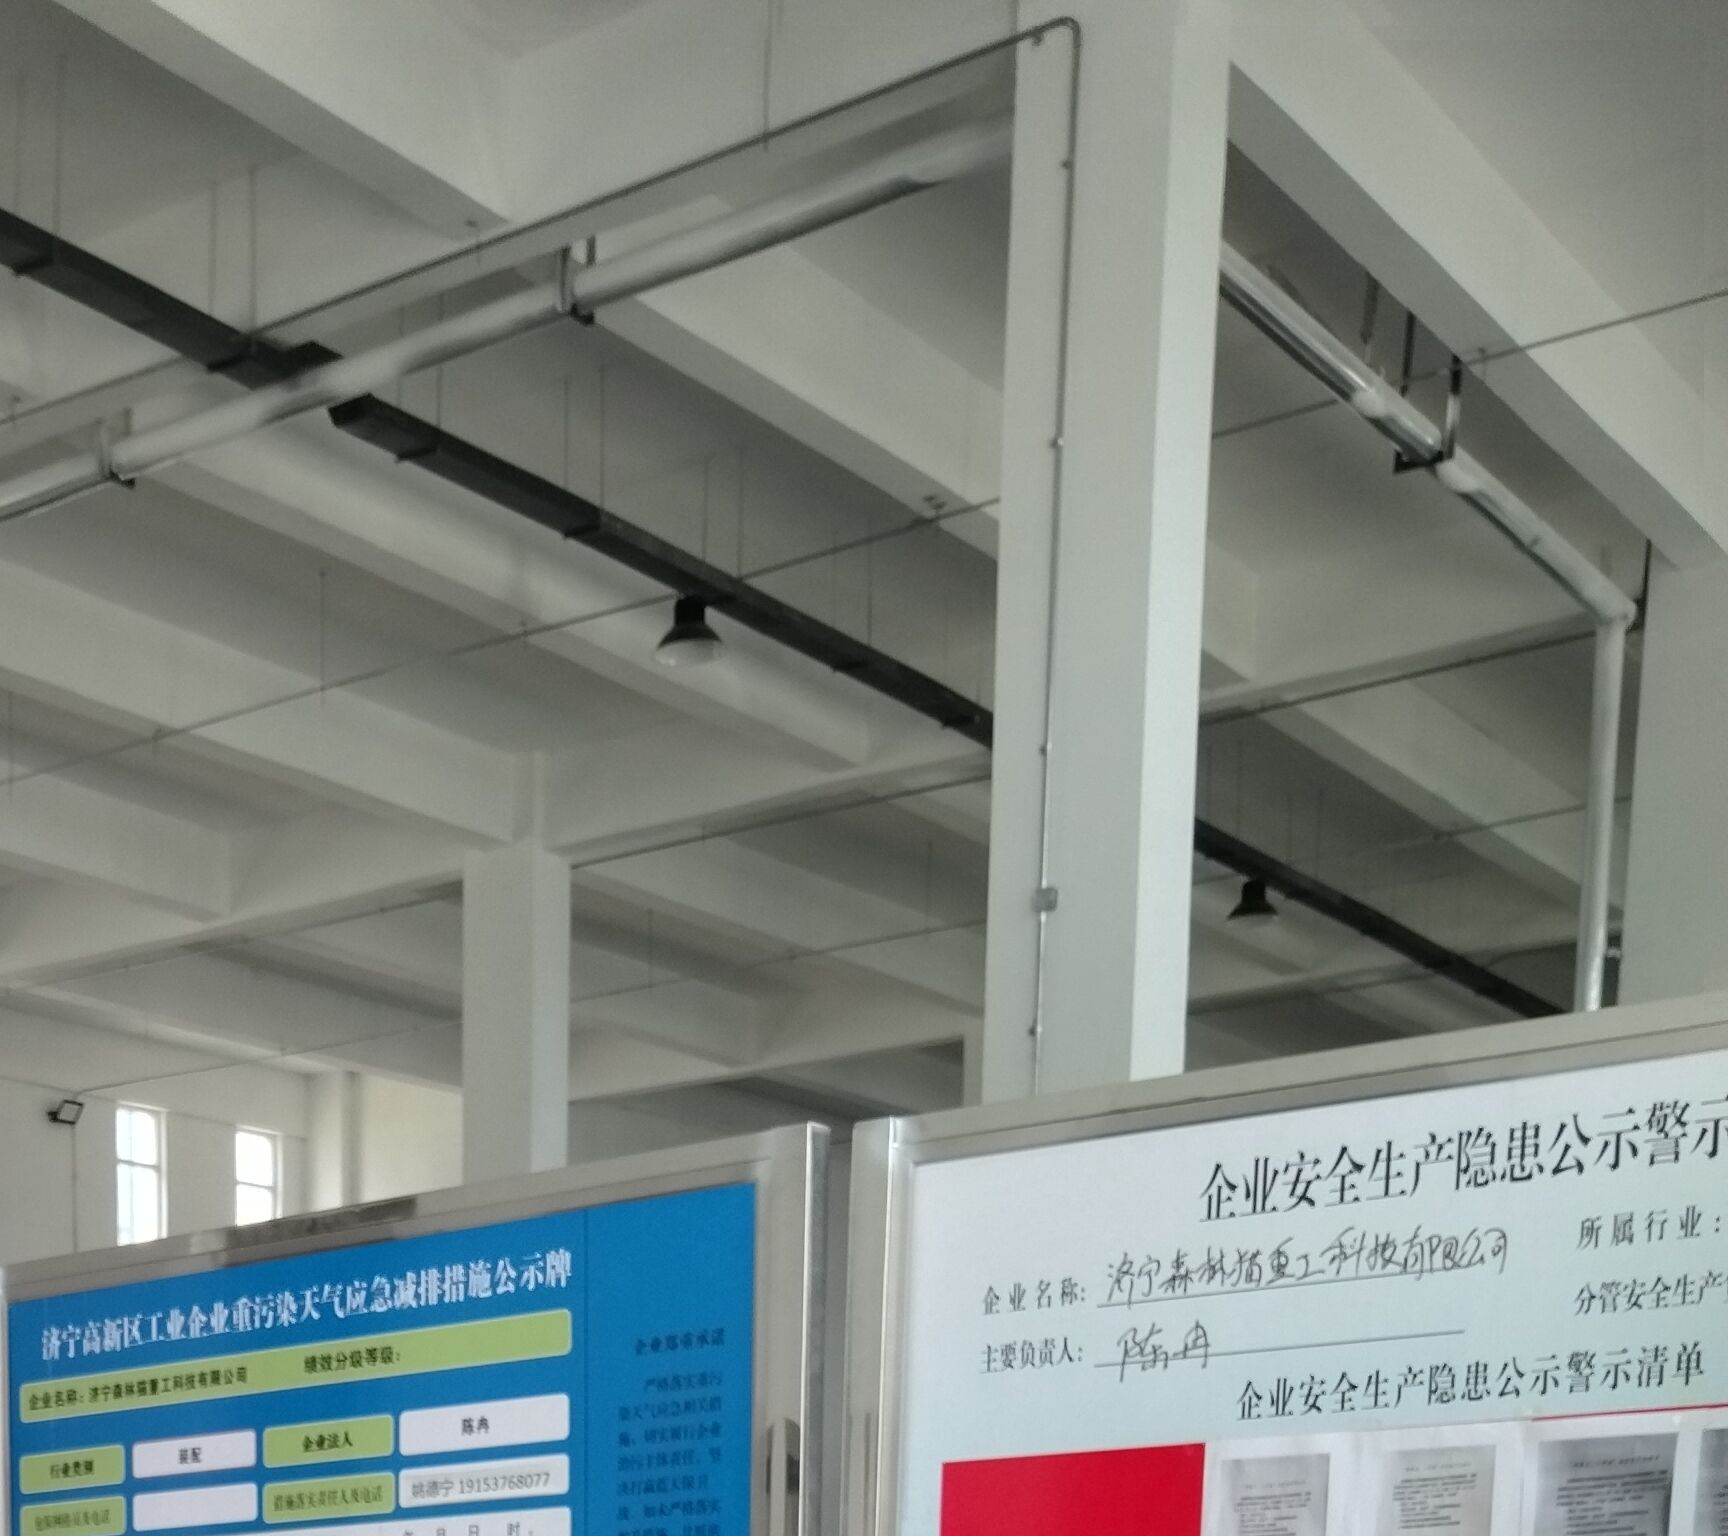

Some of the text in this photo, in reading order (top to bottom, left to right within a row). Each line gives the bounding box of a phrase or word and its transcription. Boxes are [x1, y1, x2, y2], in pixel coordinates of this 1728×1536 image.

[1199, 1096, 1728, 1223] 企业安全生产隐患公示警示
[40, 1248, 572, 1361] 济宁高新区工业企业重污染天气应急减排措施公示牌
[983, 1280, 1086, 1316] 企业名称：
[1572, 1270, 1728, 1316] 分管安全生产
[980, 1339, 1083, 1374] 主要负责人：
[1236, 1341, 1704, 1421] 企业安全生产隐患公示警示清单
[179, 1448, 202, 1464] 装配
[302, 1432, 353, 1453] 企业法人
[459, 1472, 551, 1495] 19153768077
